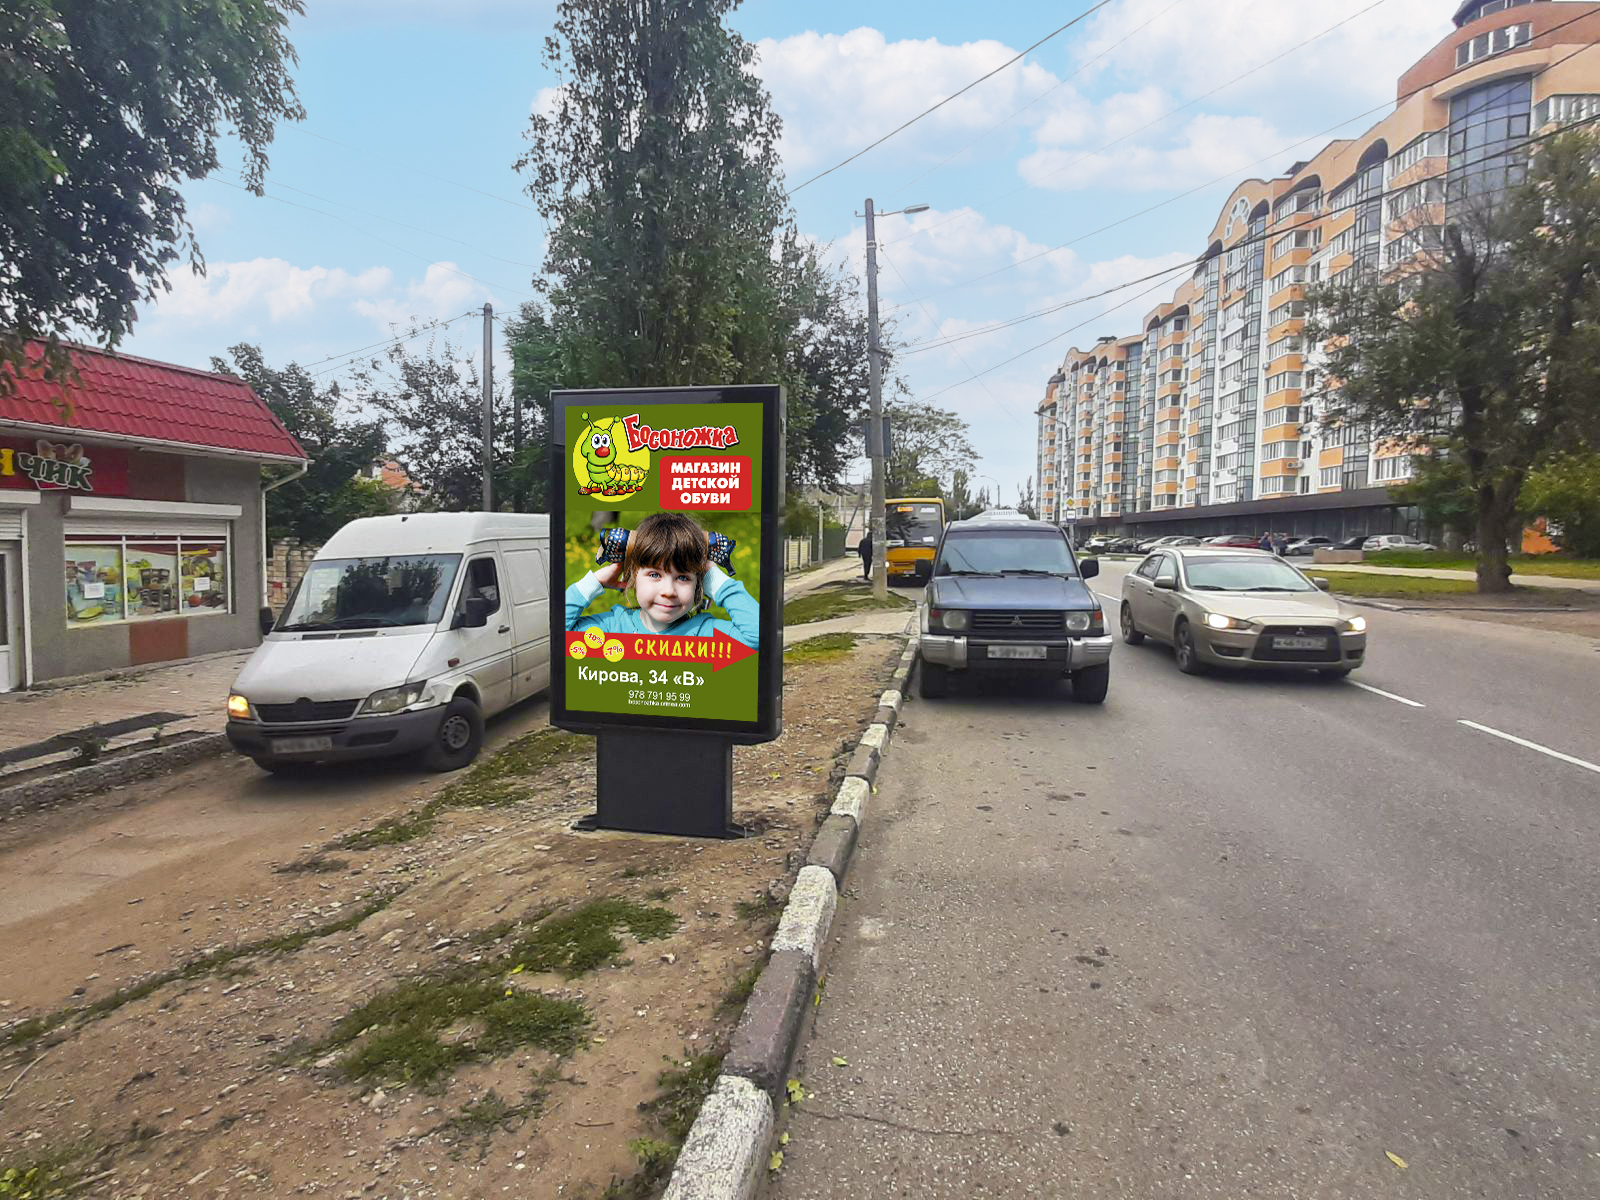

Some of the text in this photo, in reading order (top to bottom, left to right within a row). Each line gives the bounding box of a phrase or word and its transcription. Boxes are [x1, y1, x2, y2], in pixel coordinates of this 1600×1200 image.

[622, 413, 740, 452] Босоножка
[671, 462, 741, 474] МАГАЗИН
[671, 475, 740, 490] ДЕТСКОЙ
[680, 492, 731, 504] ОБУВИ
[585, 632, 603, 645] -10%
[570, 647, 586, 656] -5%
[605, 646, 623, 656] -7%
[634, 638, 732, 659] СКИДКИ!!!
[578, 665, 643, 686] Кирова,
[648, 669, 669, 685] 34
[628, 689, 691, 702] 978 791 95 99
